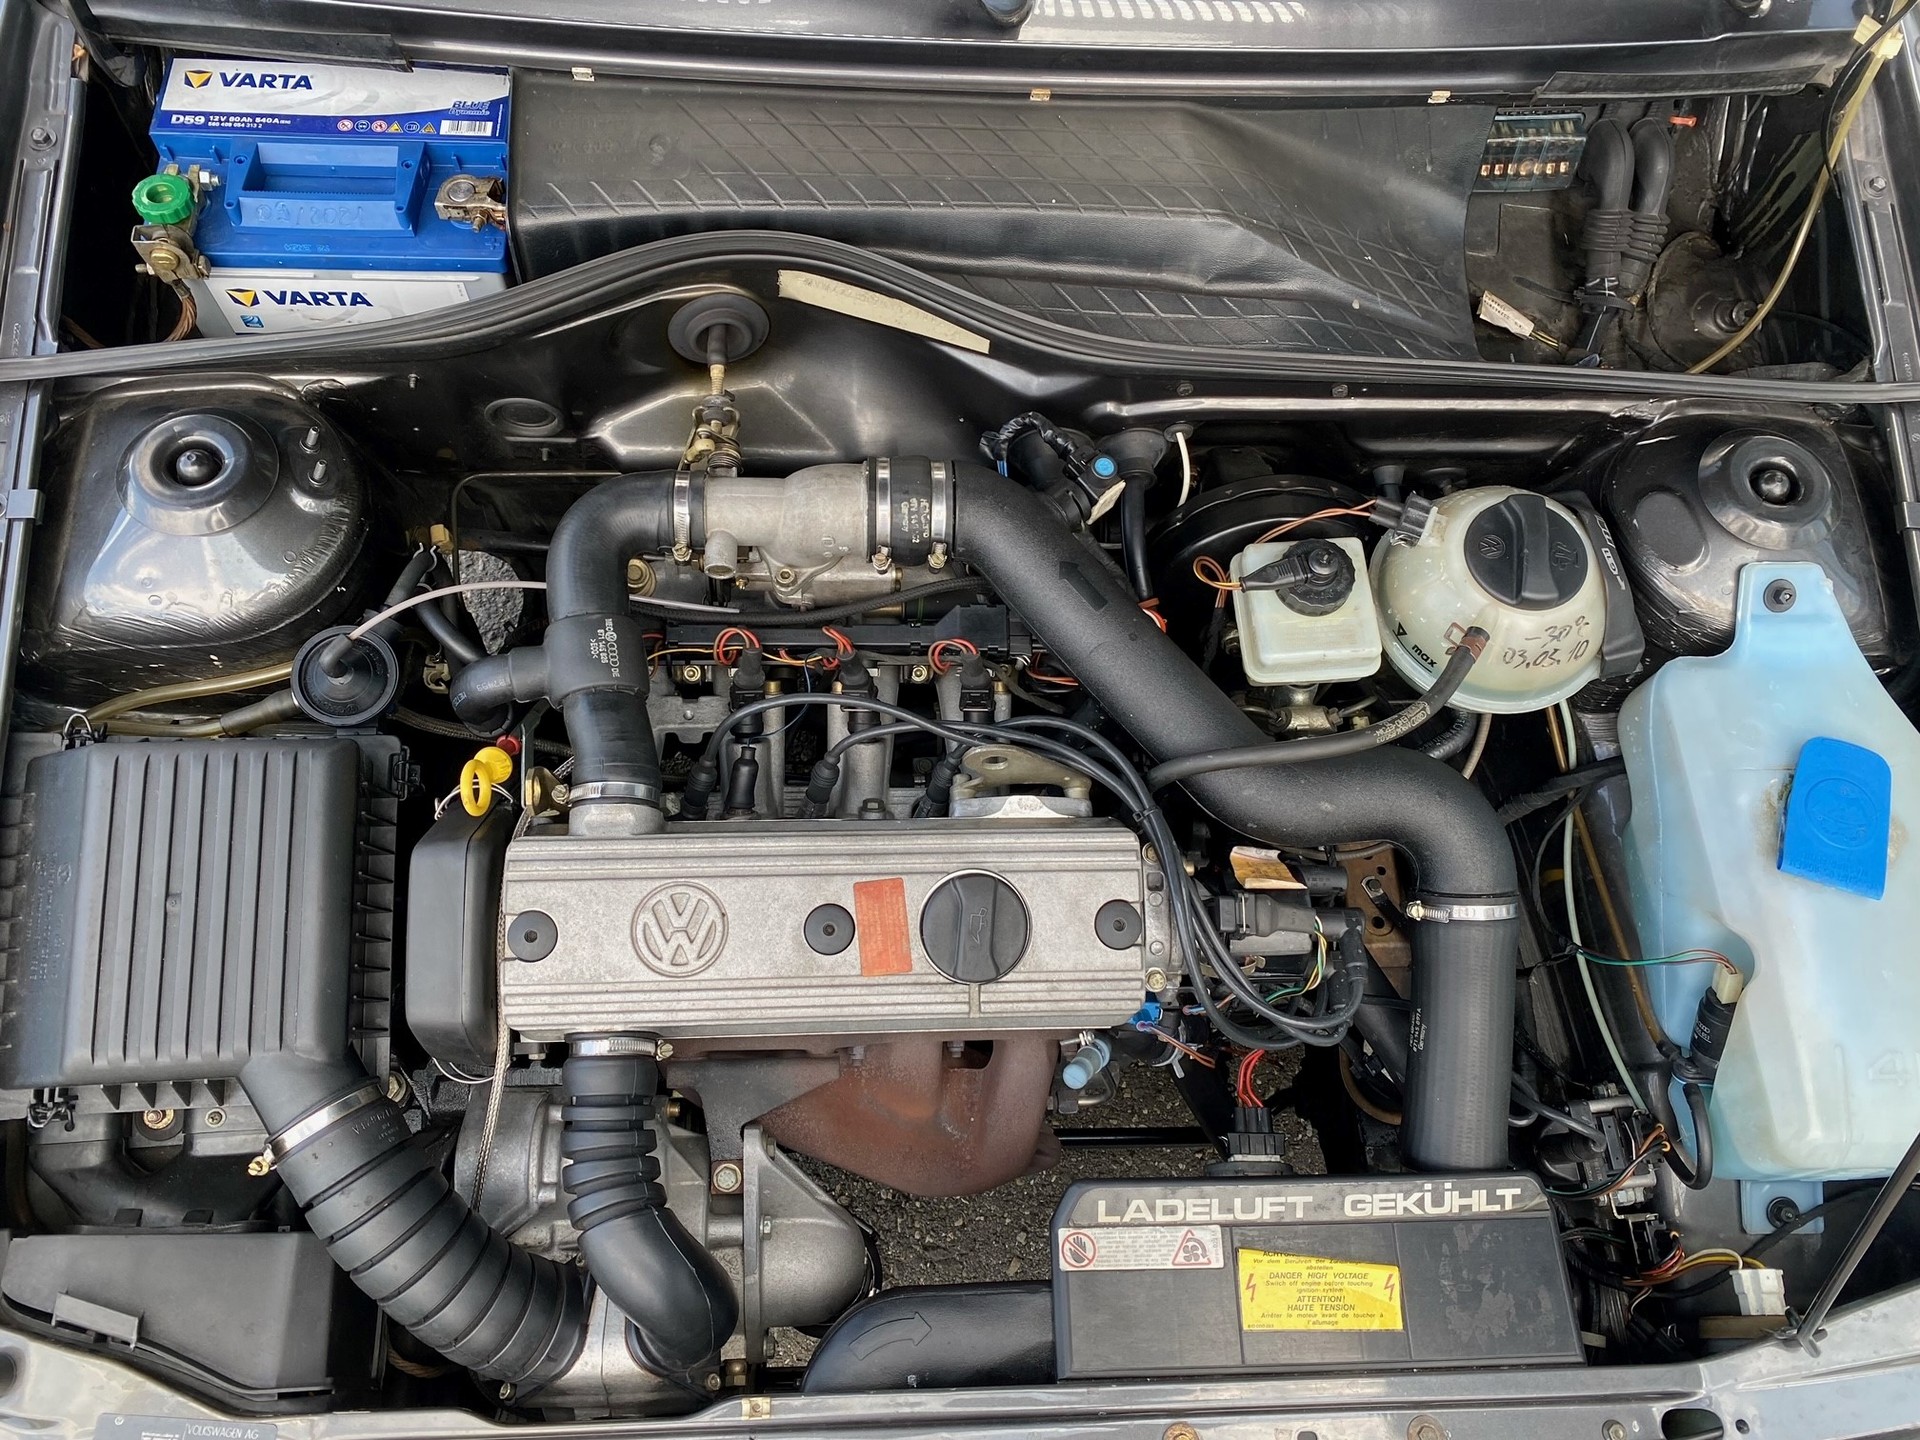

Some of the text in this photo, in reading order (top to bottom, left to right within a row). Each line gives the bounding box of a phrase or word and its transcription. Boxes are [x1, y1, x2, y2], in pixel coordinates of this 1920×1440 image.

[220, 72, 312, 90] VARTA
[171, 114, 205, 125] D59
[262, 289, 373, 307] VARTA
[1412, 644, 1437, 668] max
[1097, 1183, 1522, 1223] LADELUFT GEKÜHLT
[187, 1424, 241, 1439] VOLKSWAGEN
[244, 1429, 259, 1439] AG
